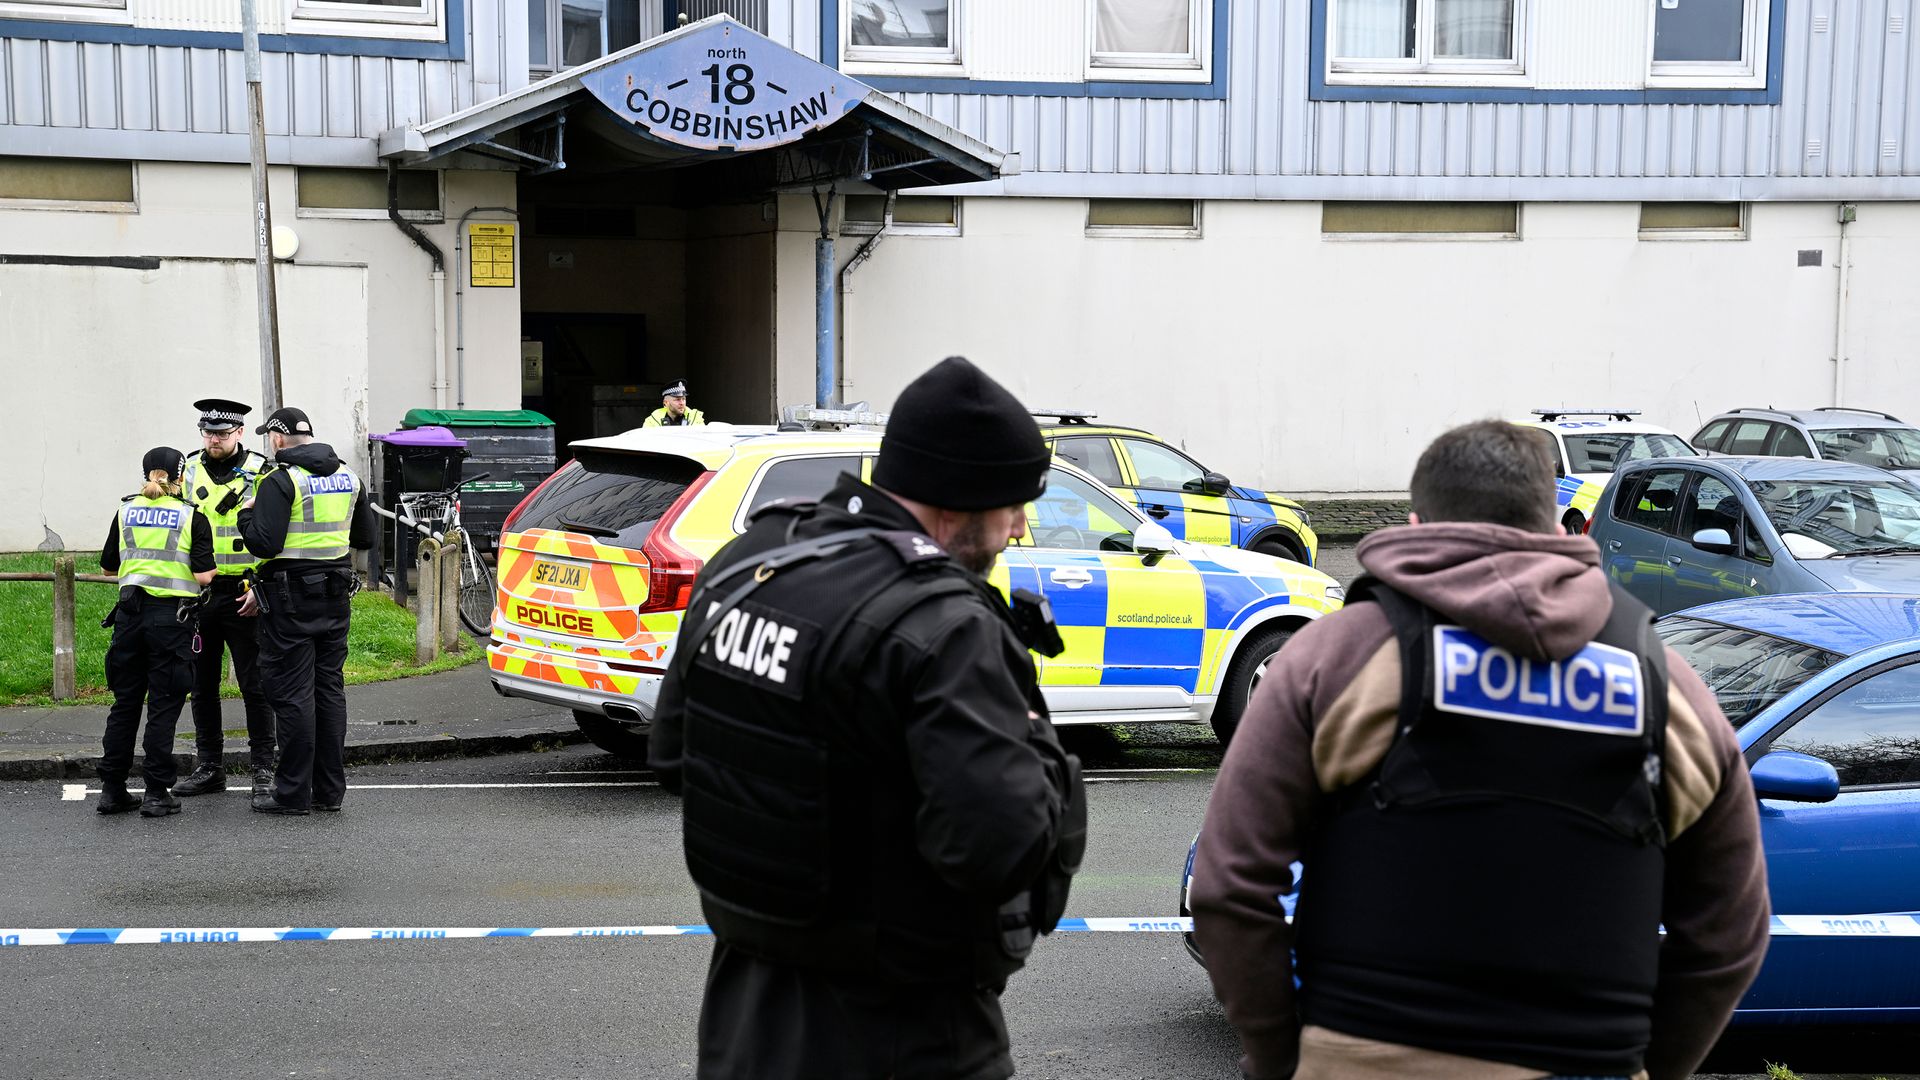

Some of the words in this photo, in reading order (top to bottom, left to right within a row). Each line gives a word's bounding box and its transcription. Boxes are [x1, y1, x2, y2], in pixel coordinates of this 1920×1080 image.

[708, 48, 746, 59] north
[702, 64, 755, 105] 18
[626, 89, 828, 141] COBBINSHAW
[310, 476, 352, 492] POLICE
[127, 508, 178, 526] POLICE
[536, 563, 560, 582] SF21
[559, 567, 581, 586] JXA
[516, 605, 594, 633] POLICE
[1117, 613, 1193, 625] scotland.police.uk
[1444, 643, 1636, 716] POLICE
[1821, 919, 1891, 934] POLICE
